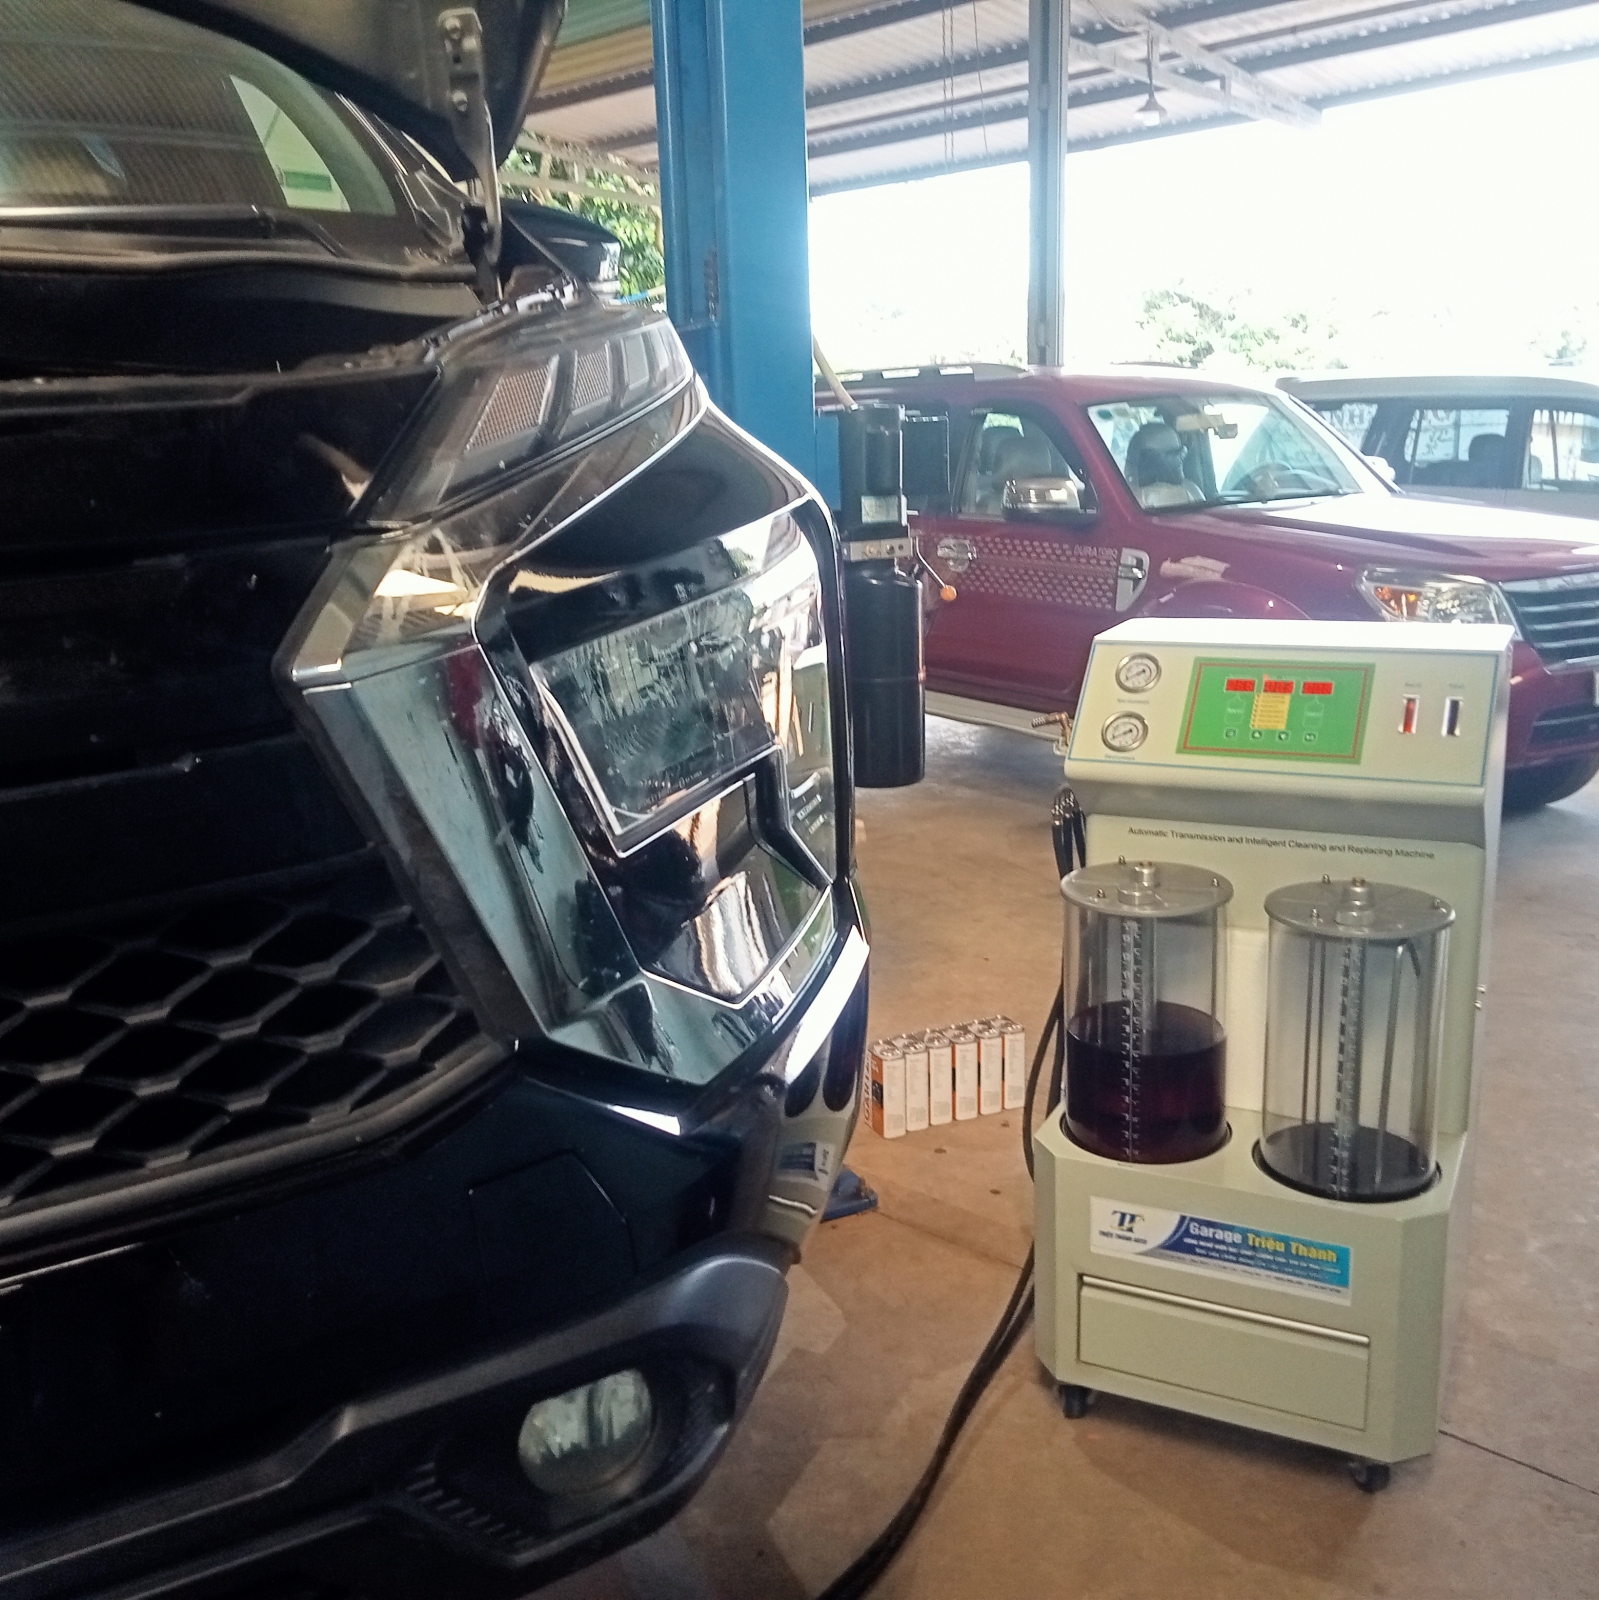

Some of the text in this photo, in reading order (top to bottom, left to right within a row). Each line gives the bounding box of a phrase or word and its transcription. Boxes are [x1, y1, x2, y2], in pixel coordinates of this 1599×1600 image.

[1128, 826, 1436, 859] Automatic Transmission and Intelligent Cleaning and Replacing Machine
[1189, 1221, 1243, 1244] Garage
